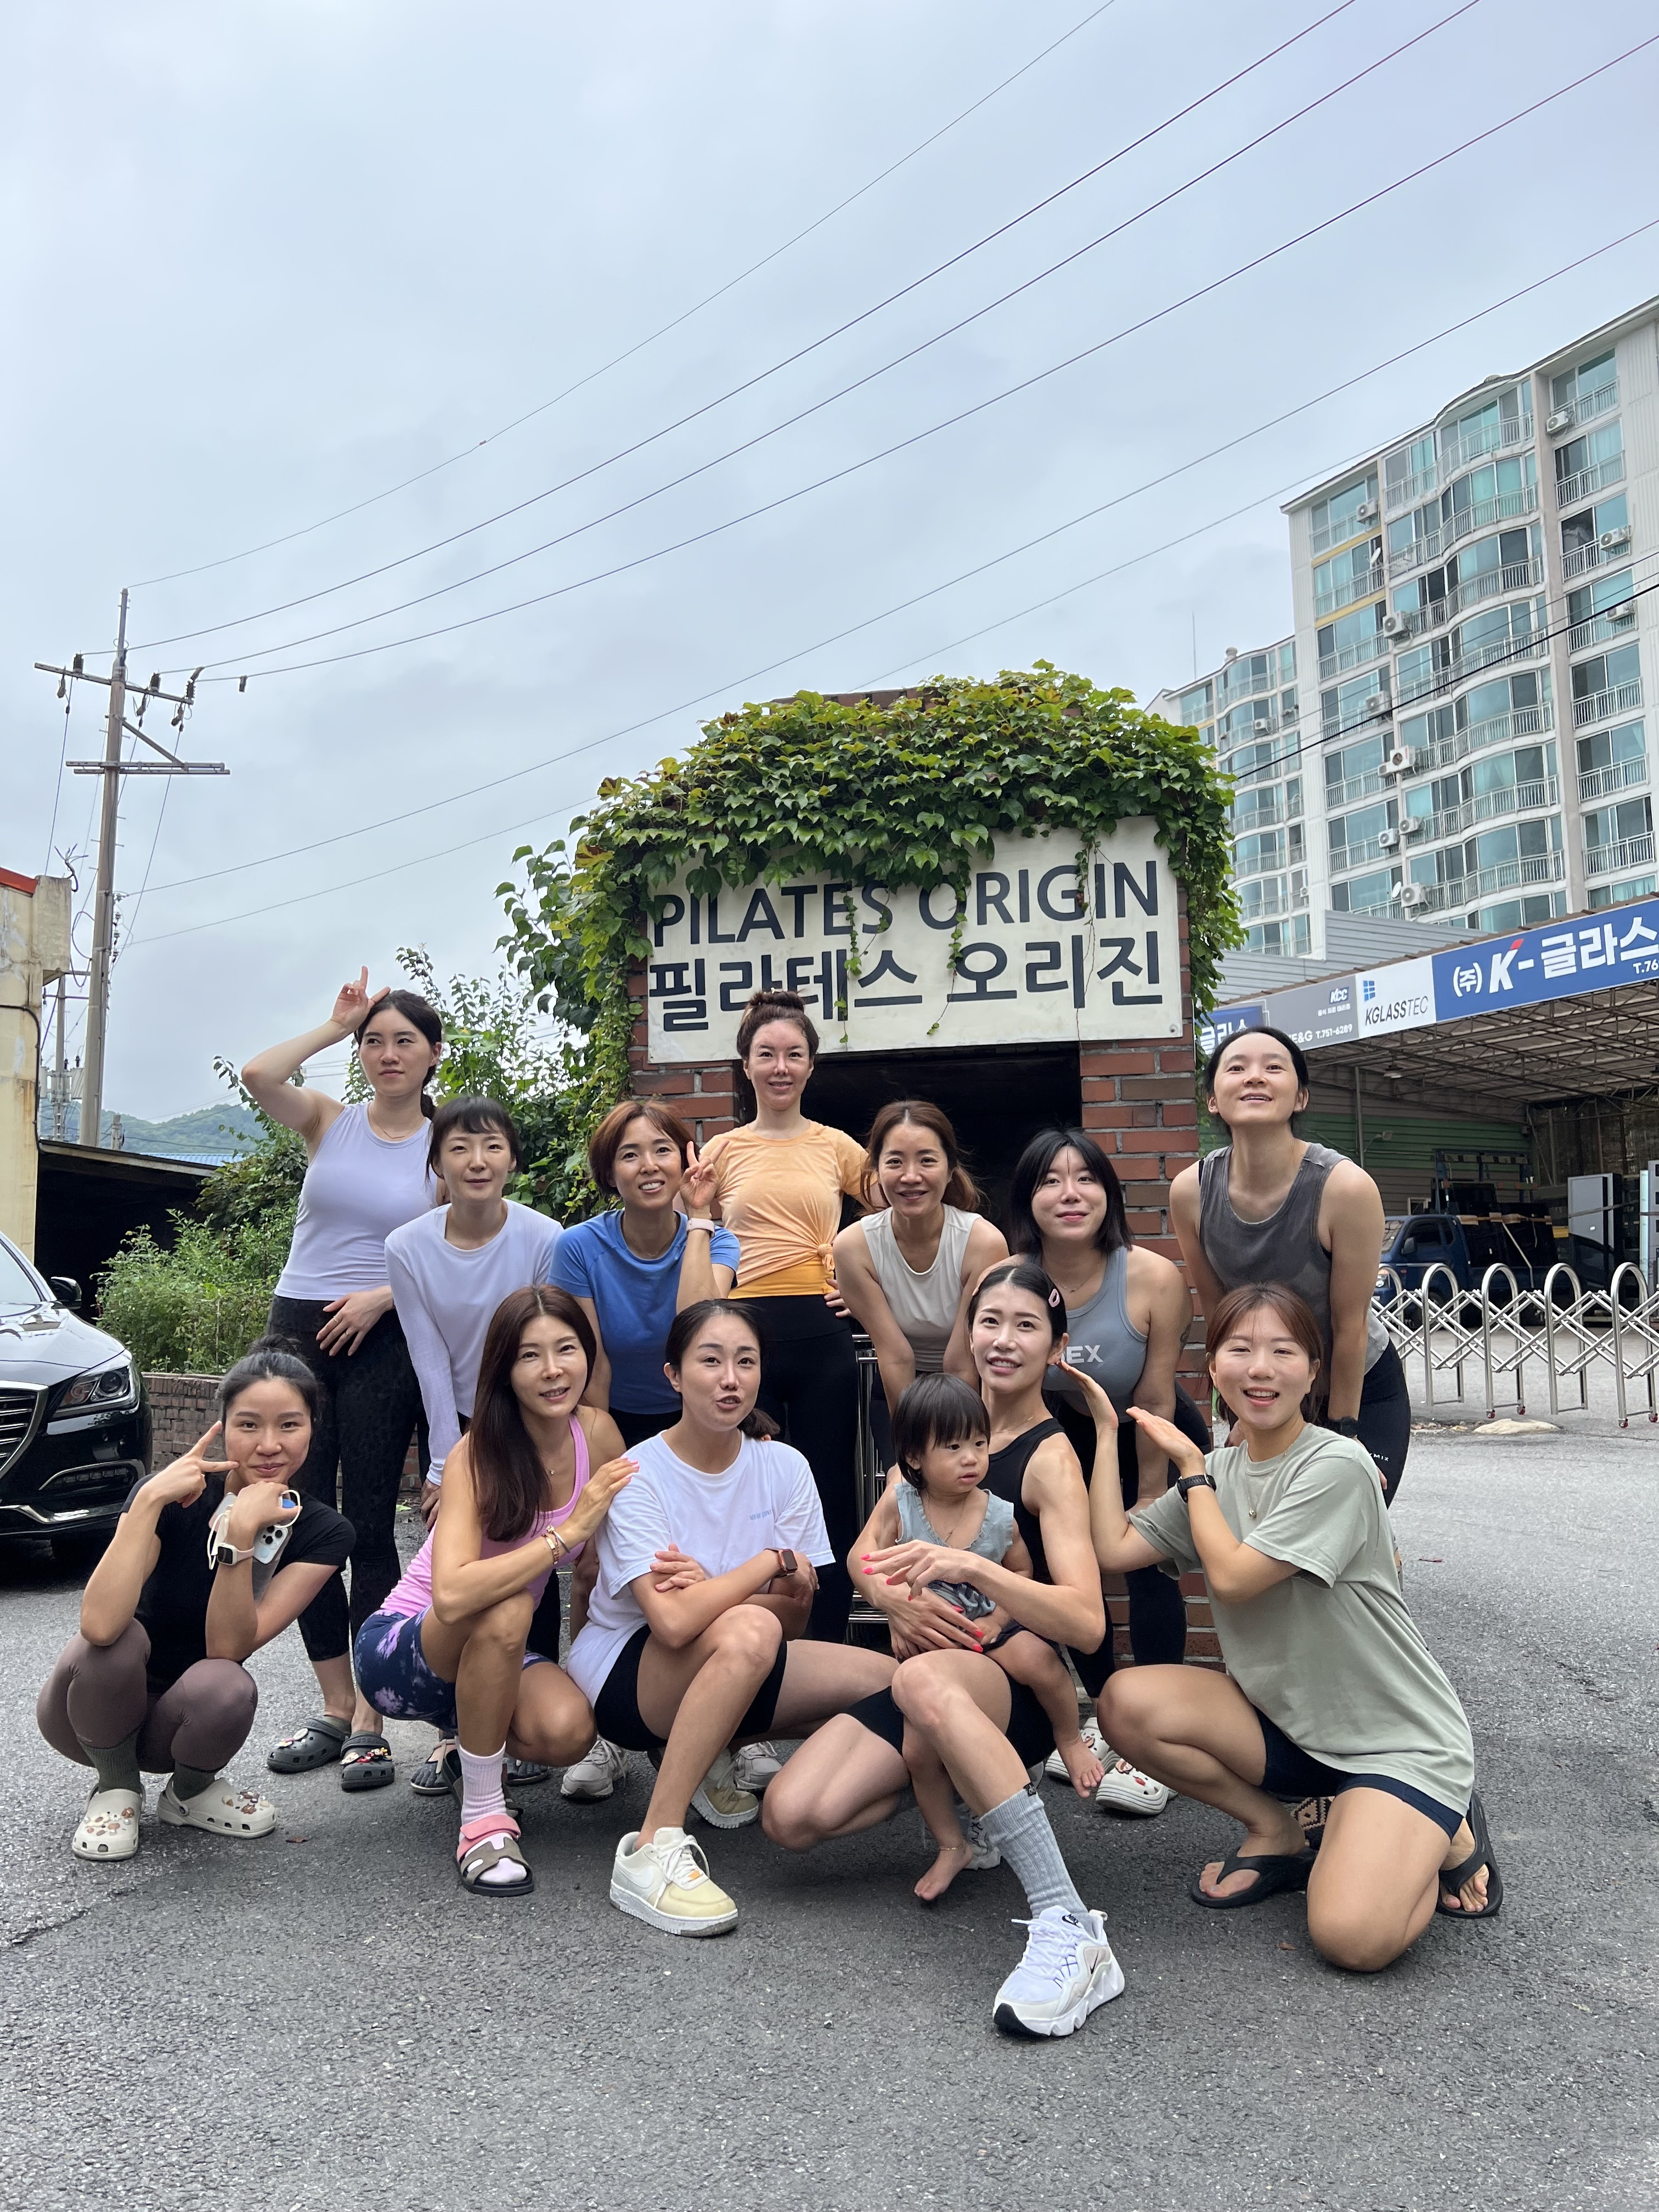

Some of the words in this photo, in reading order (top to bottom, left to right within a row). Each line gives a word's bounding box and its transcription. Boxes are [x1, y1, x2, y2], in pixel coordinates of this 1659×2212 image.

[654, 879, 893, 947] PILATES
[918, 860, 1158, 930] ORIGIN
[1633, 959, 1659, 974] T.76
[649, 949, 923, 1031] 필라테스
[946, 931, 1163, 1009] 오리진
[1330, 988, 1348, 1003] KCC
[1365, 996, 1429, 1025] KGLASSTEC
[1316, 1024, 1353, 1039] T.751-6289
[1061, 1345, 1104, 1364] EX
